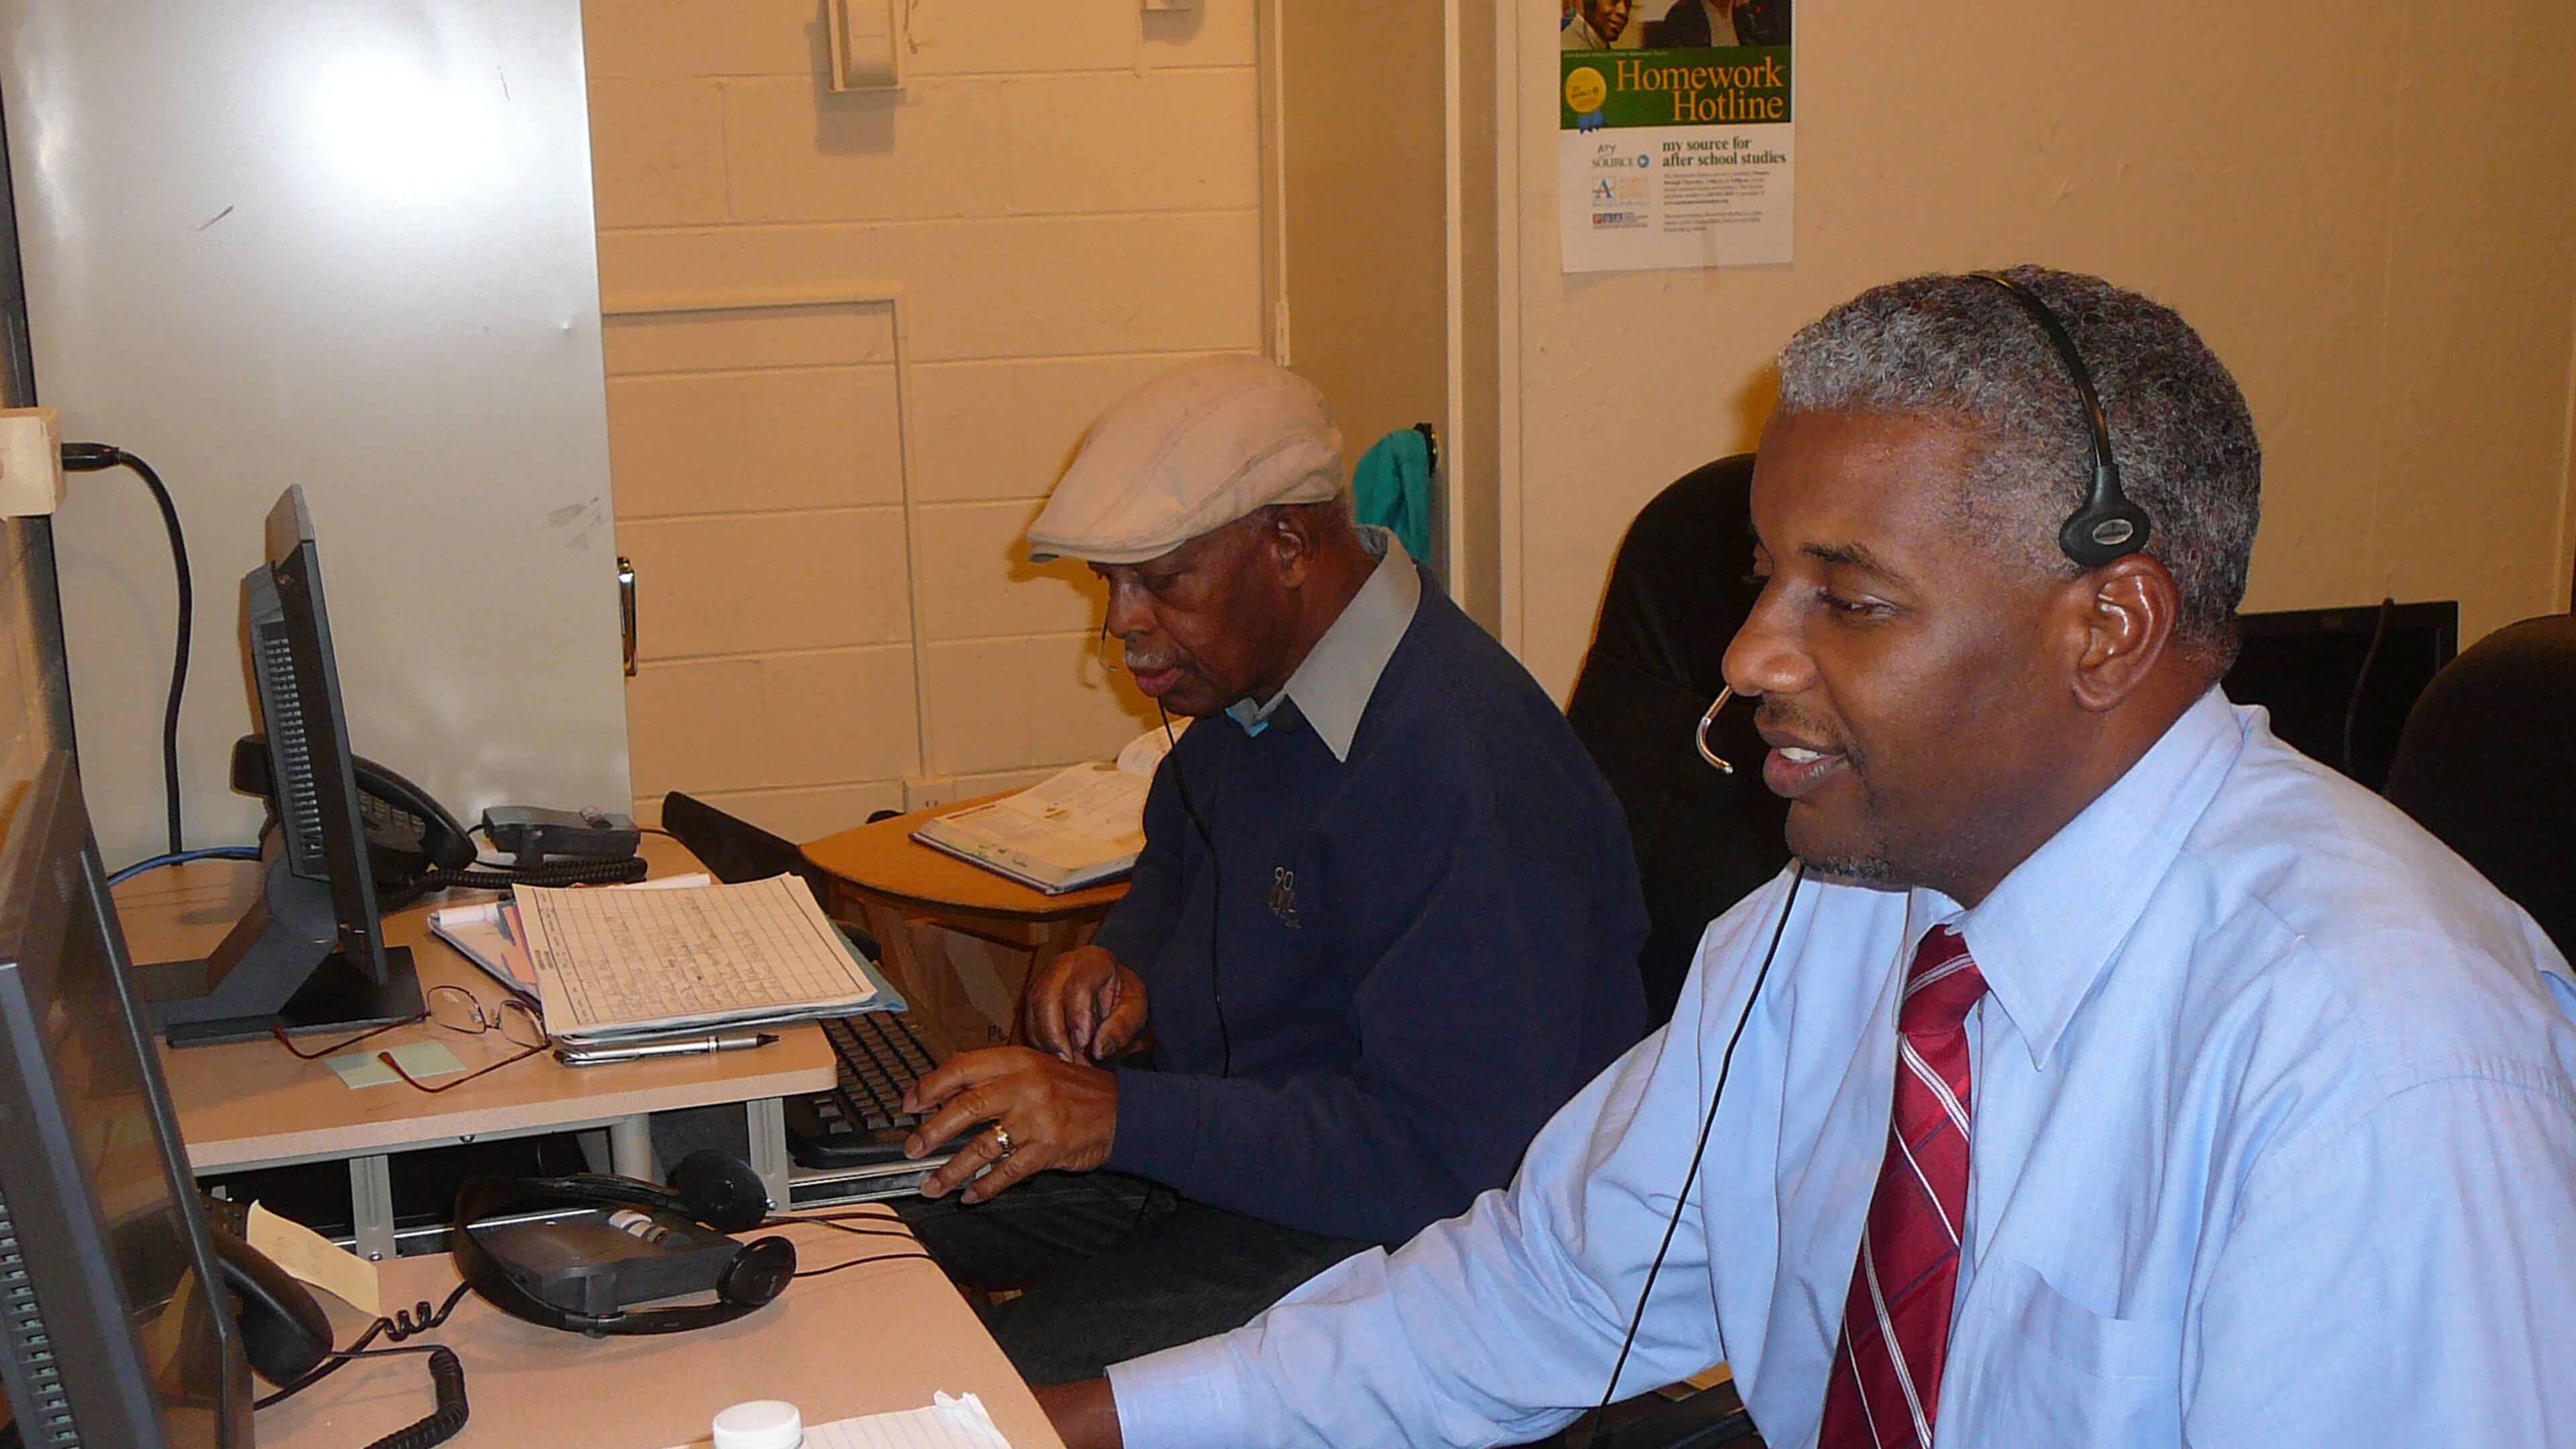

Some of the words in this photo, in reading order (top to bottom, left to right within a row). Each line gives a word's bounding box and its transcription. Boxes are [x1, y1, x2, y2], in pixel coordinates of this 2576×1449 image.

[1615, 56, 1786, 92] Homework
[1672, 88, 1784, 121] Hotline
[1662, 140, 1684, 154] my
[1686, 138, 1730, 152] source
[1733, 136, 1752, 150] for
[1662, 152, 1695, 167] after
[1697, 151, 1738, 166] school
[1740, 150, 1786, 164] studies
